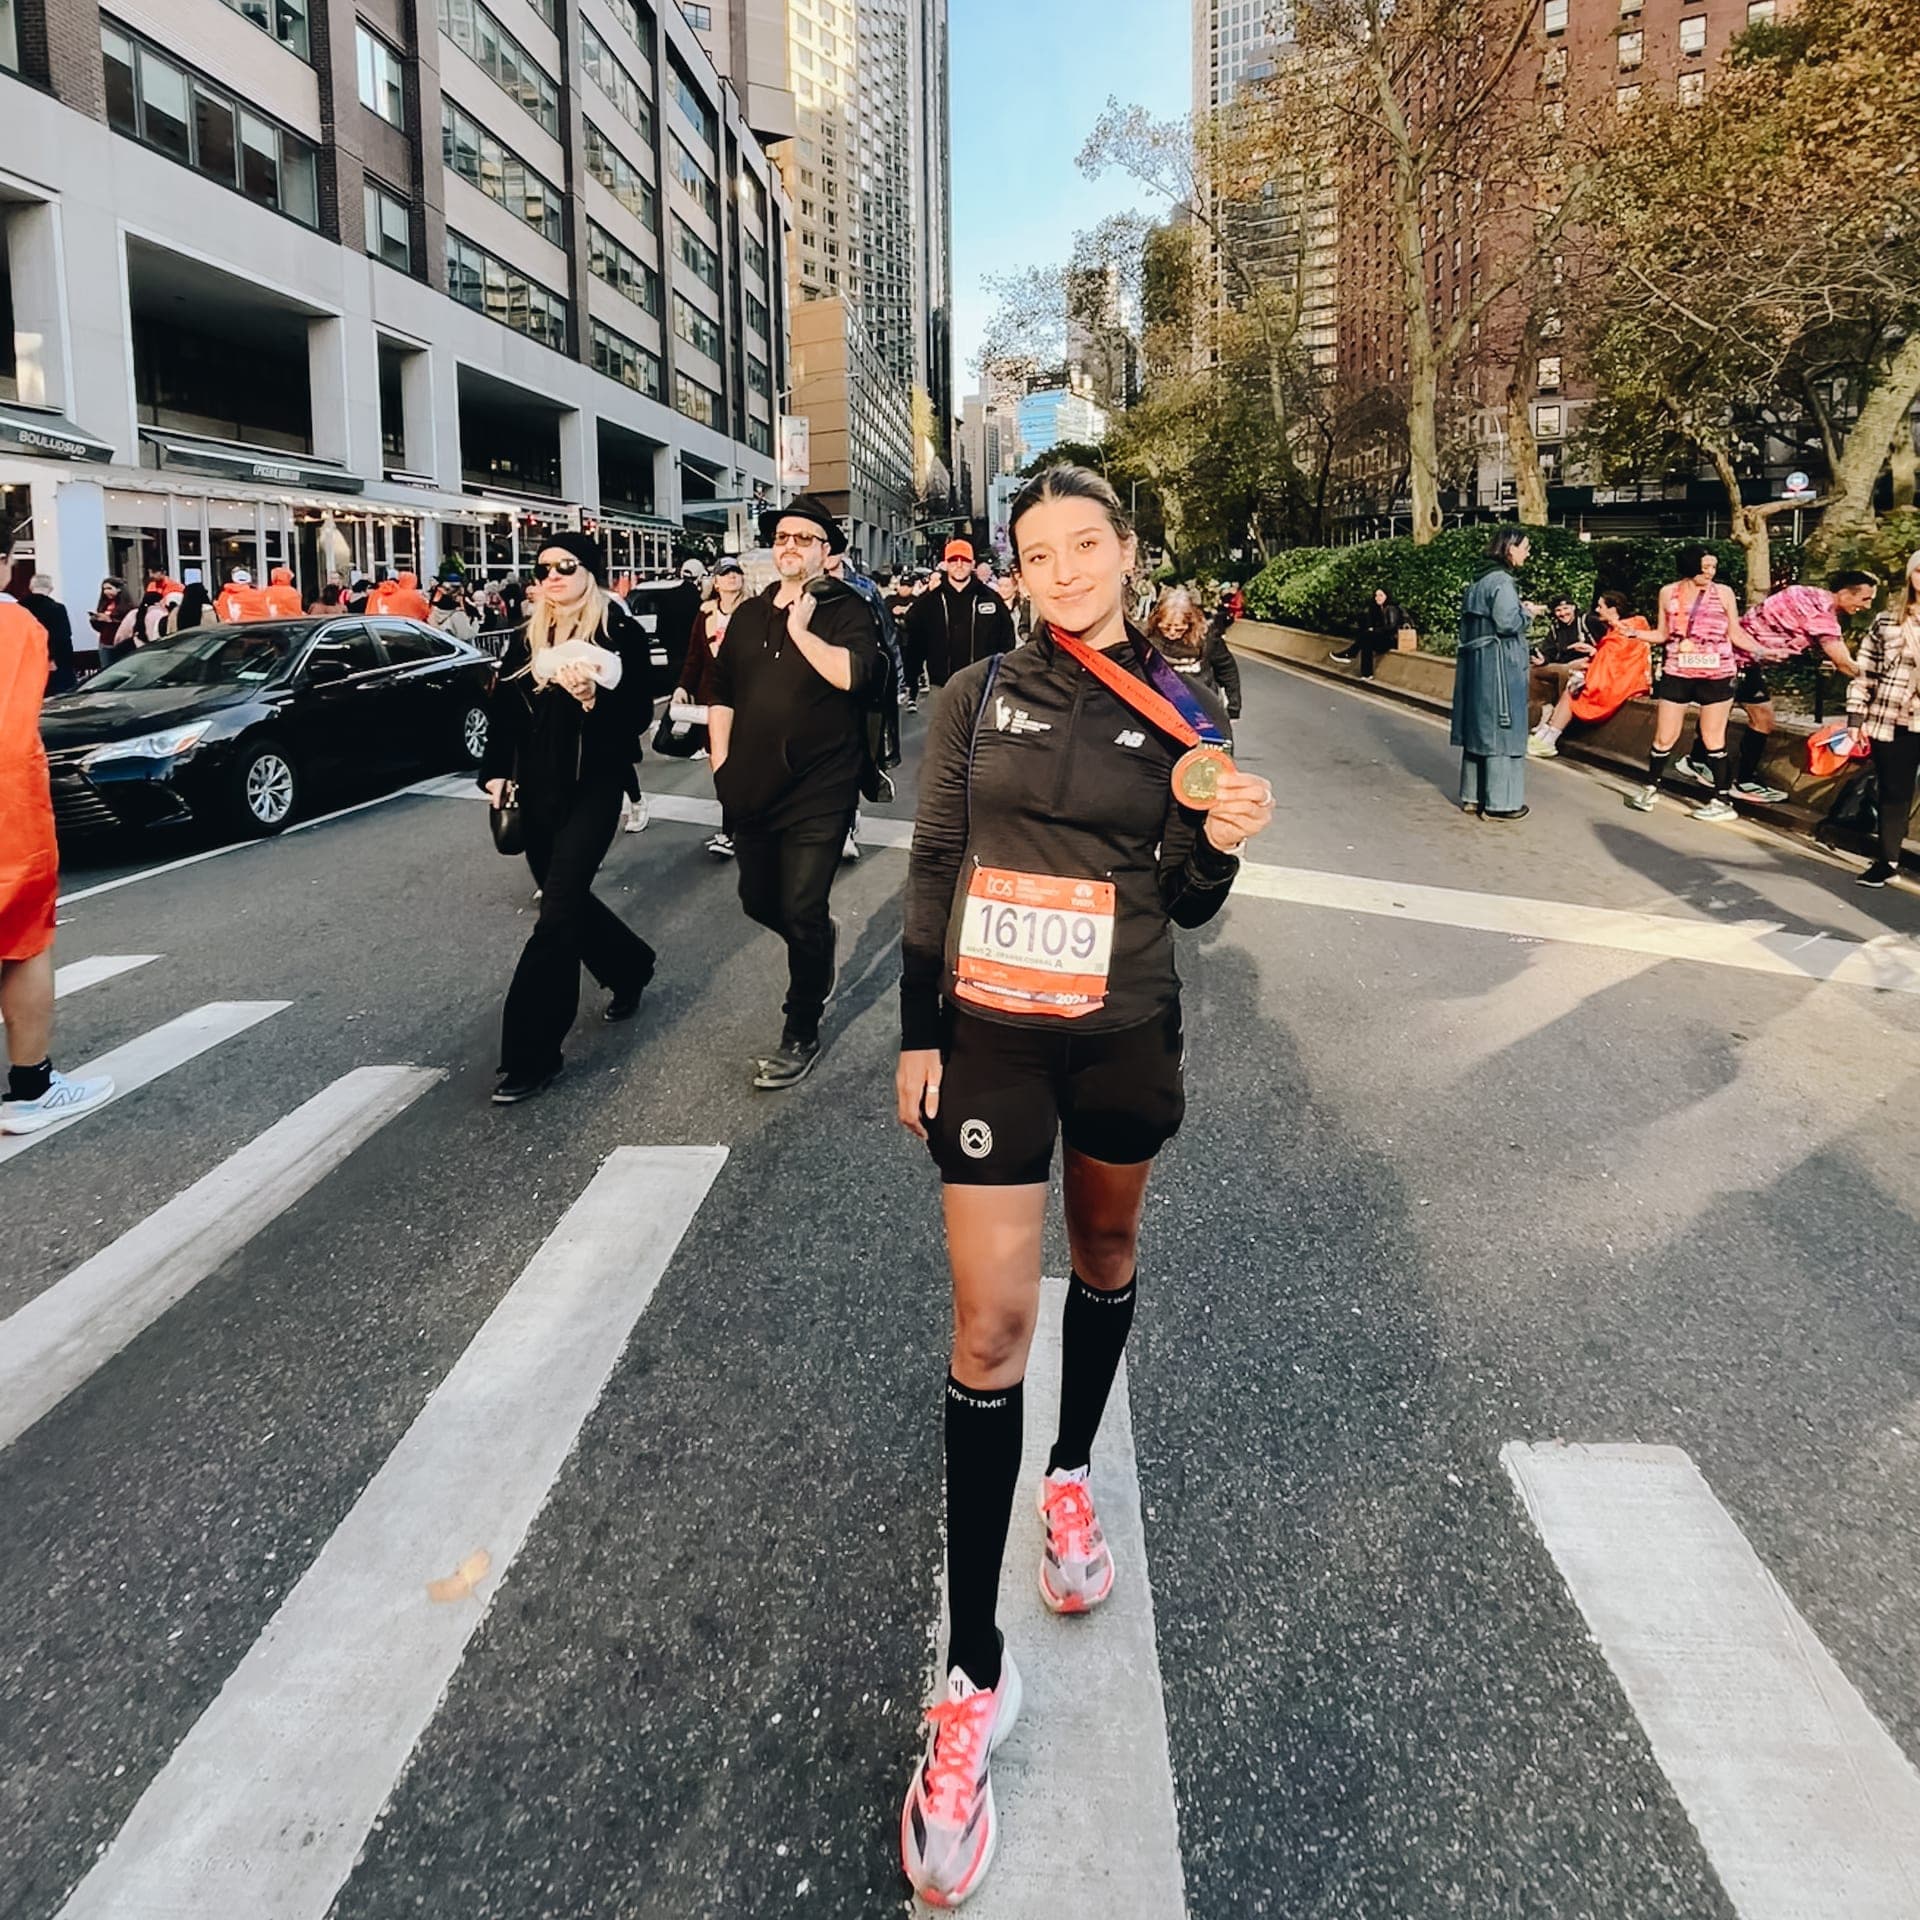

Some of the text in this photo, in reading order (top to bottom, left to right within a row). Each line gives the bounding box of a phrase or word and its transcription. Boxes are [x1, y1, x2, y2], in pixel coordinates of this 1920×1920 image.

[981, 904, 1096, 959] 16109
[985, 946, 993, 957] 2
[1054, 959, 1064, 968] A
